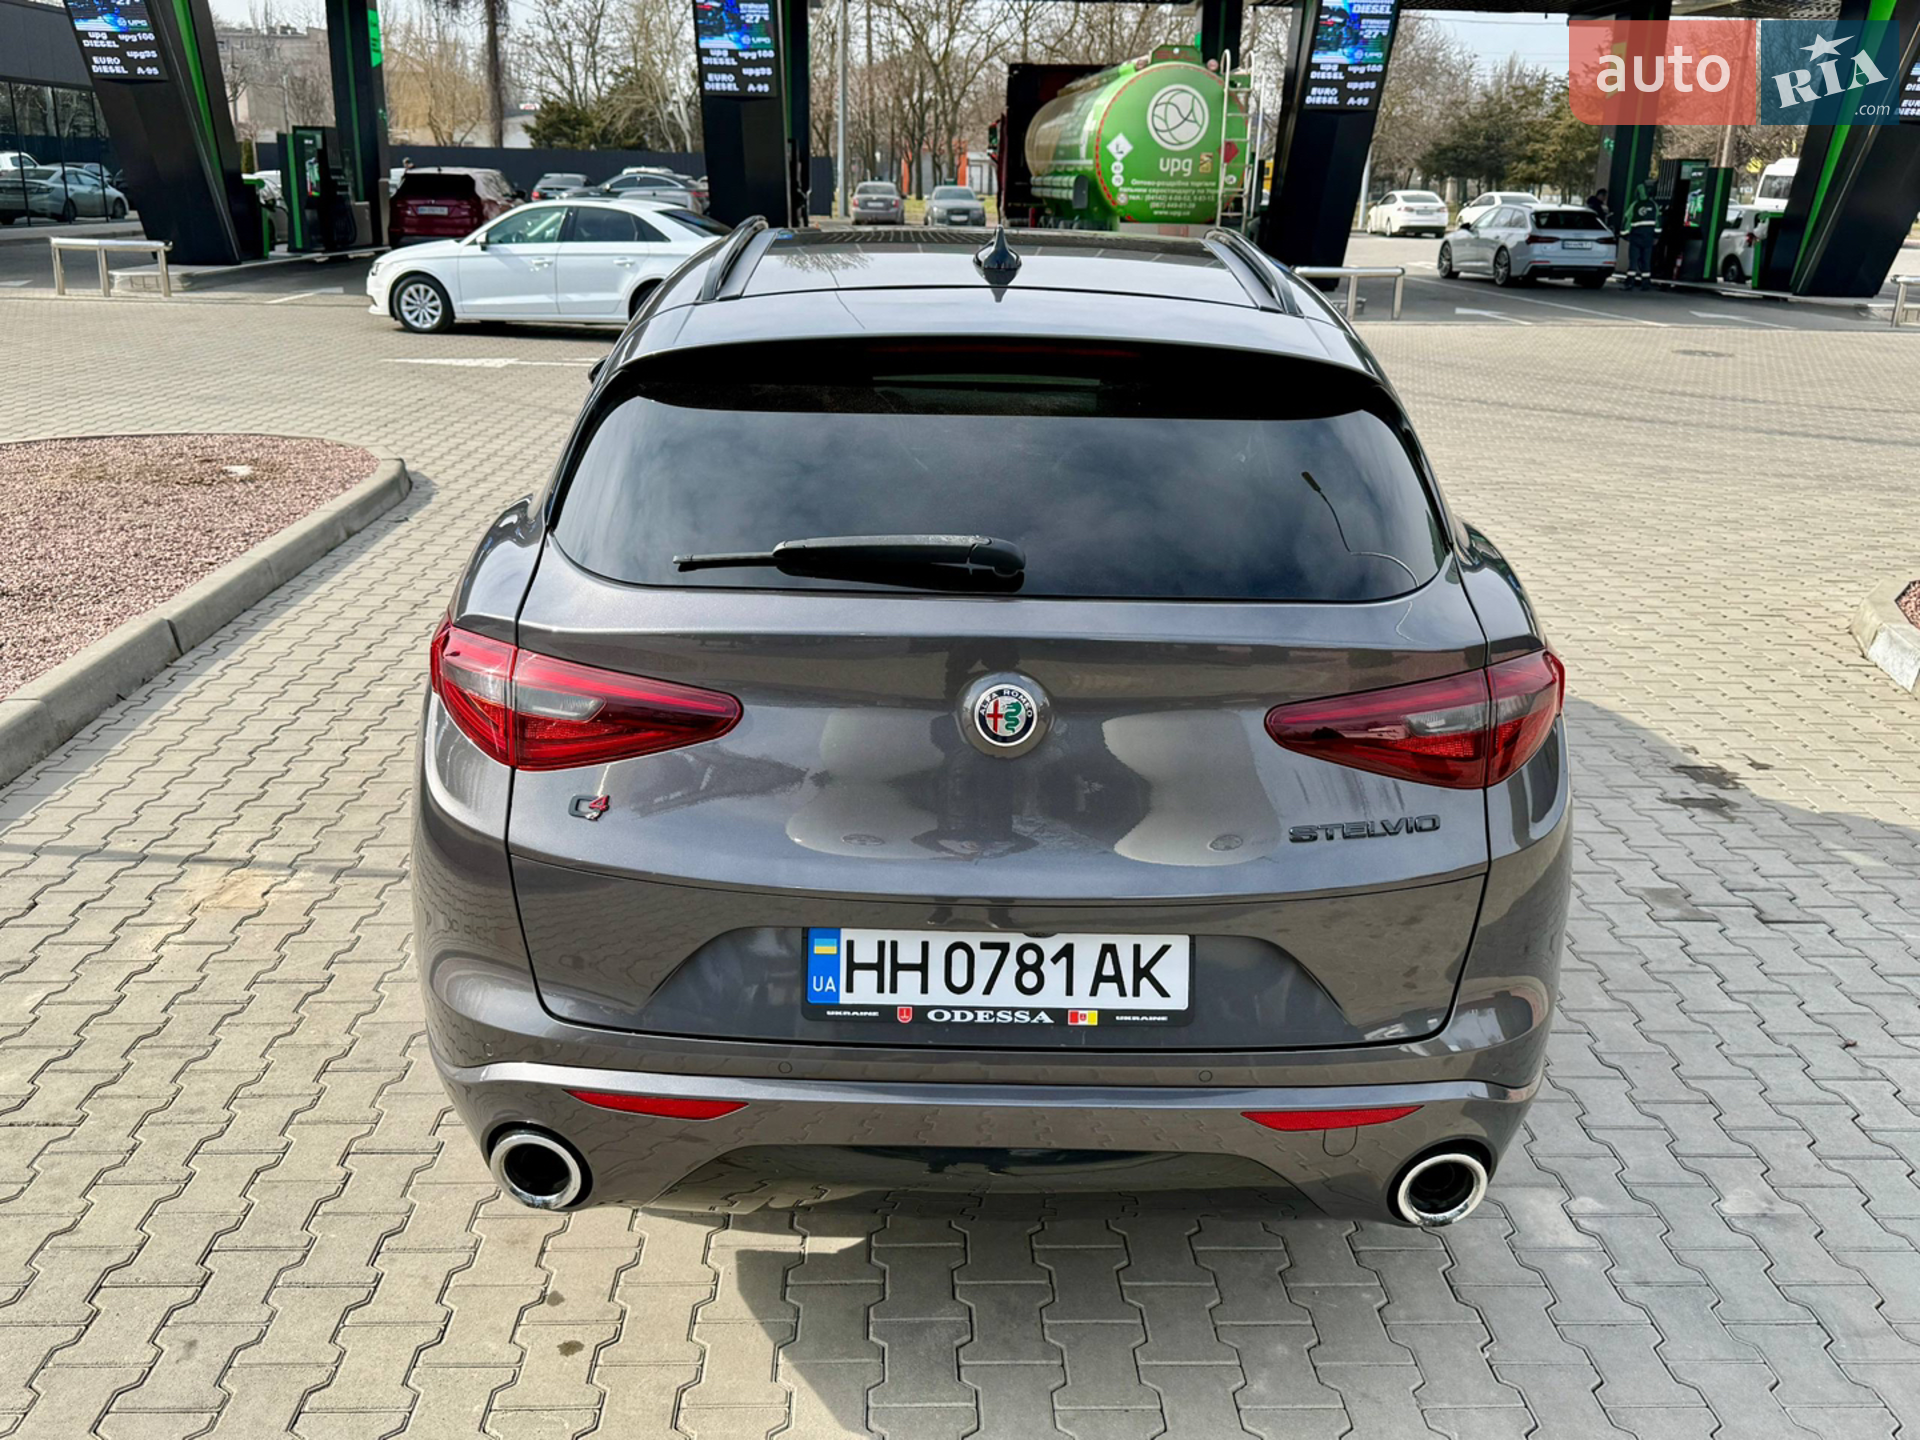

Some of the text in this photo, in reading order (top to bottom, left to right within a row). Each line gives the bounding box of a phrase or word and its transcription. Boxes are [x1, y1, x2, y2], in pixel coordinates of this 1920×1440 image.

[1352, 4, 1392, 14] DIESEL
[87, 31, 108, 40] upg
[82, 39, 119, 48] DIESEL
[92, 56, 121, 65] EURO
[702, 56, 738, 65] DIESEL
[92, 65, 128, 74] DIESEL
[707, 73, 735, 82] EURO
[1310, 71, 1345, 80] DIESEL
[704, 82, 740, 91] DIESEL
[1310, 87, 1339, 96] EURO
[1305, 95, 1340, 105] DIESEL
[1159, 156, 1193, 177] upg
[980, 689, 1033, 718] ALFA ROMEO
[568, 795, 610, 821] Q4
[1289, 814, 1441, 843] STELVIO
[845, 940, 1172, 998] HH 0781 AK
[812, 976, 836, 992] UA
[927, 1009, 1054, 1024] ODESSA
